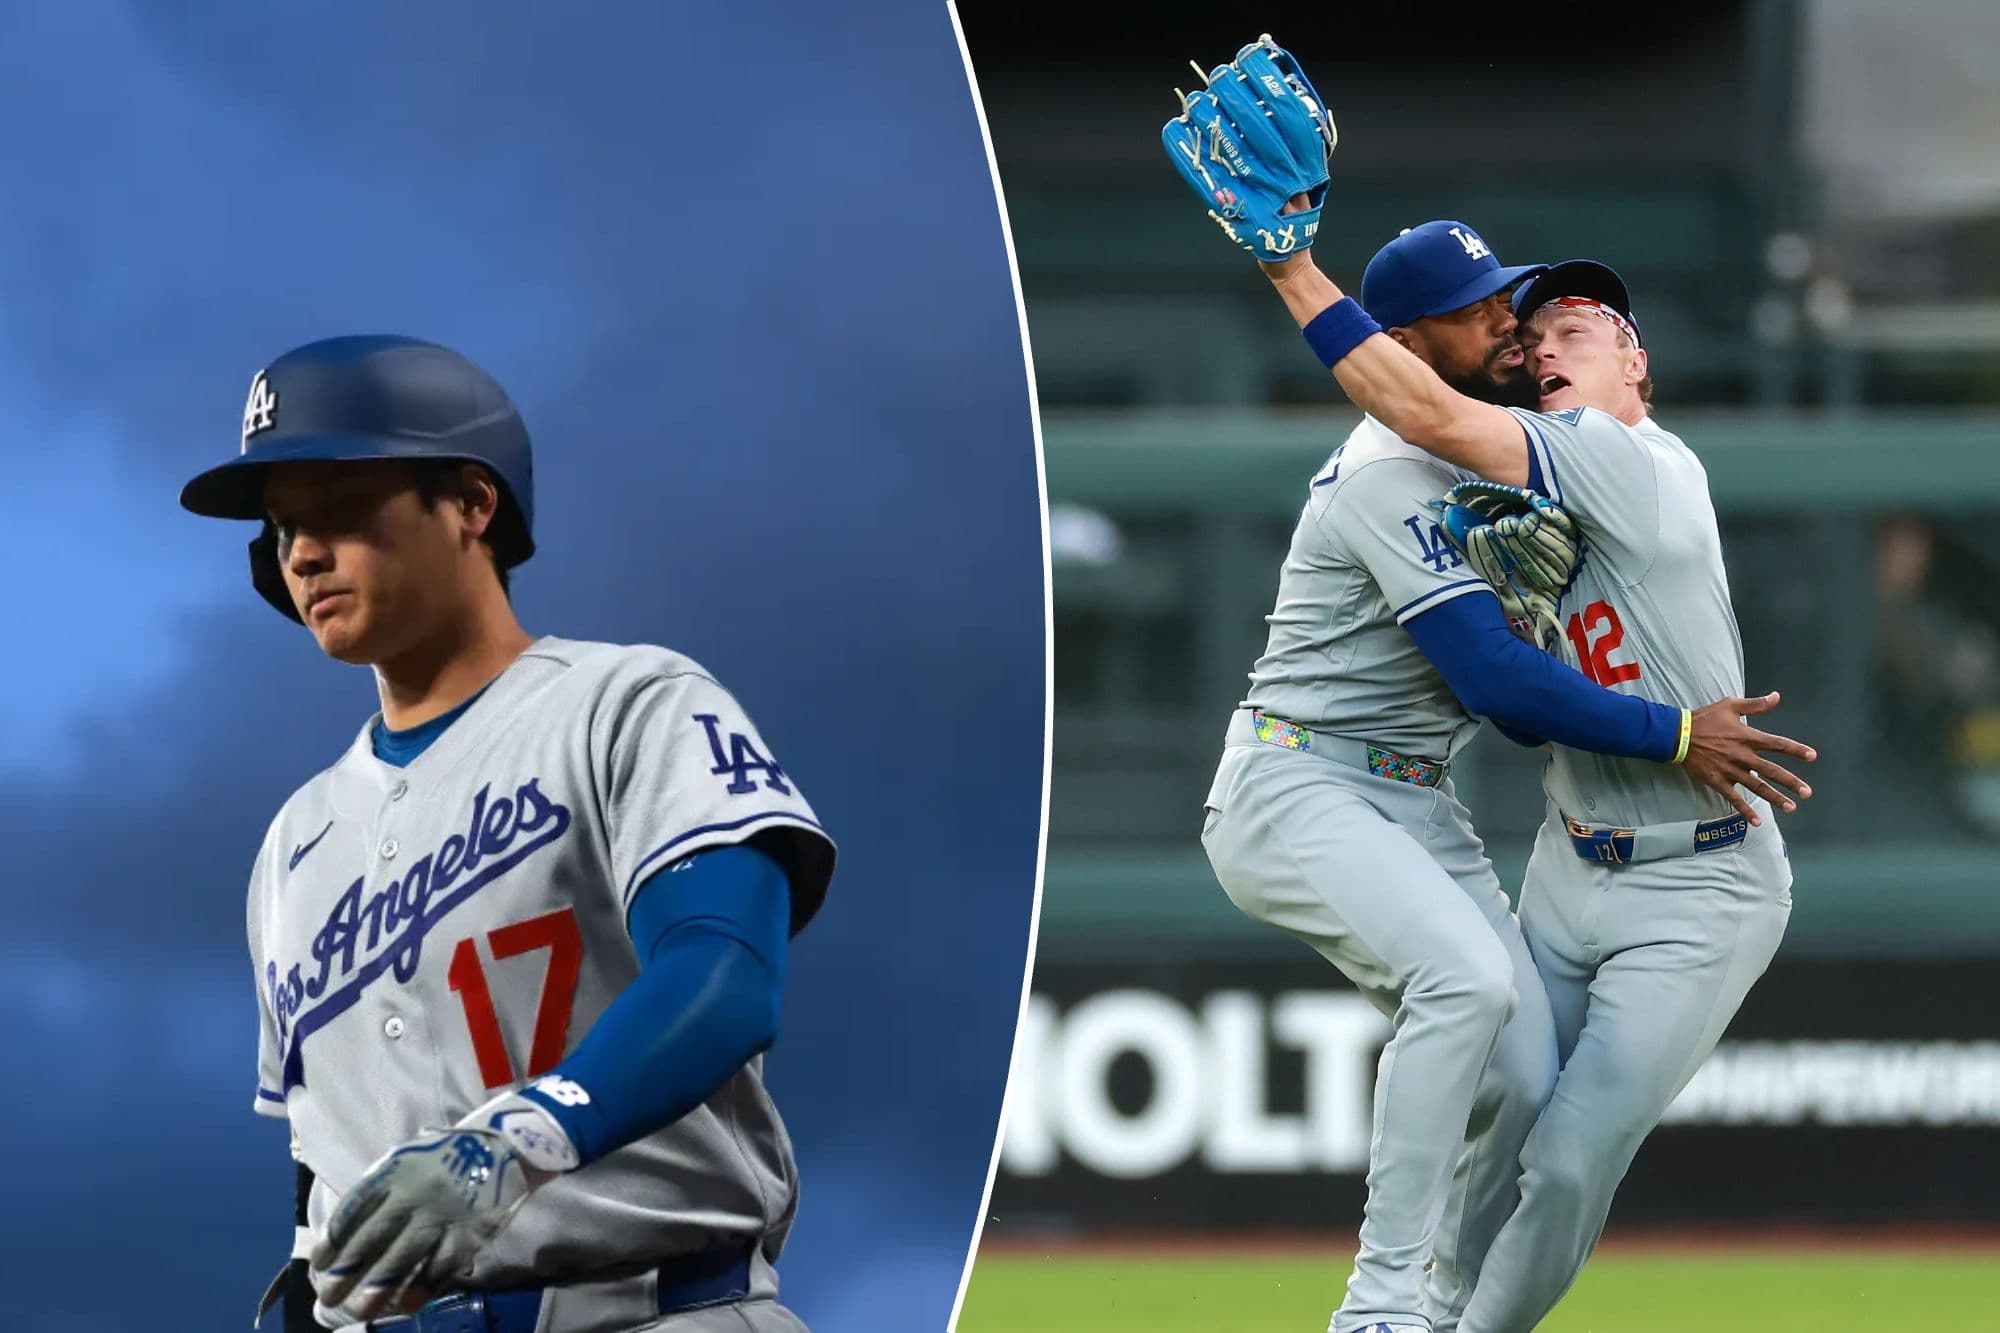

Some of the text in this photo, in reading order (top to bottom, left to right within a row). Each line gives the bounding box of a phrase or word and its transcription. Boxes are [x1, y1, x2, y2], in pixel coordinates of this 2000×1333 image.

[1448, 227, 1490, 260] LA
[243, 369, 276, 437] LA
[1403, 514, 1465, 573] LA
[1566, 600, 1642, 688] 12
[692, 713, 791, 796] LA
[306, 777, 571, 998] Angeles
[448, 905, 584, 1091] 17
